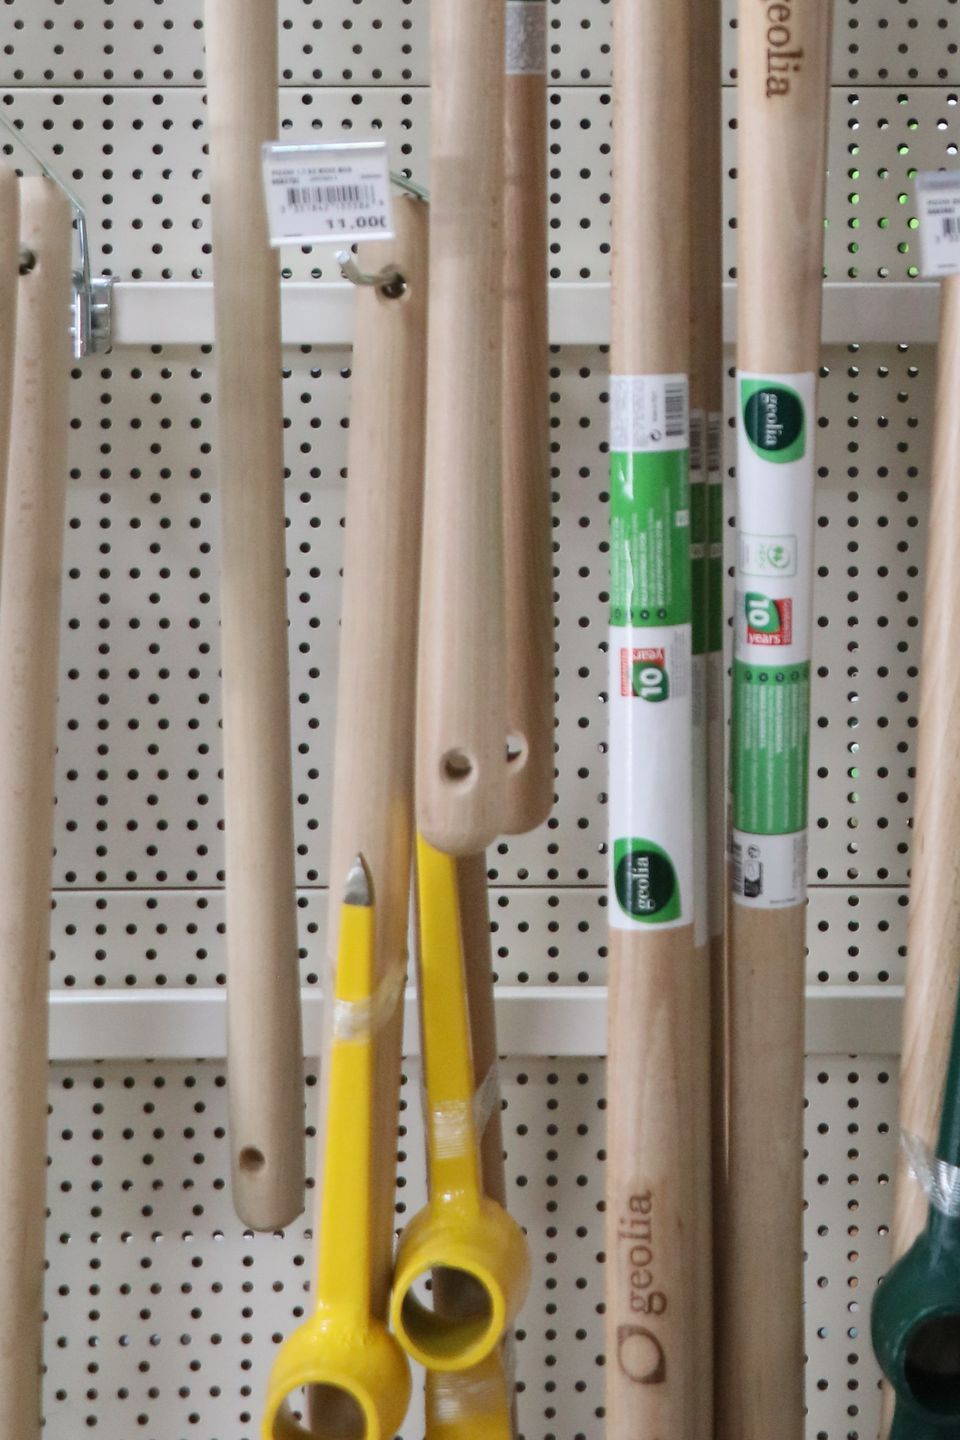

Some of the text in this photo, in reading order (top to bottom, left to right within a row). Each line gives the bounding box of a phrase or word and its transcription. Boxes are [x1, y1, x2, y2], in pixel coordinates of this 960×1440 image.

[760, 392, 784, 446] geolia
[749, 599, 770, 627] 10
[748, 634, 781, 645] years
[639, 667, 663, 697] 10
[632, 856, 656, 911] geolia
[617, 1189, 668, 1316] geolia
